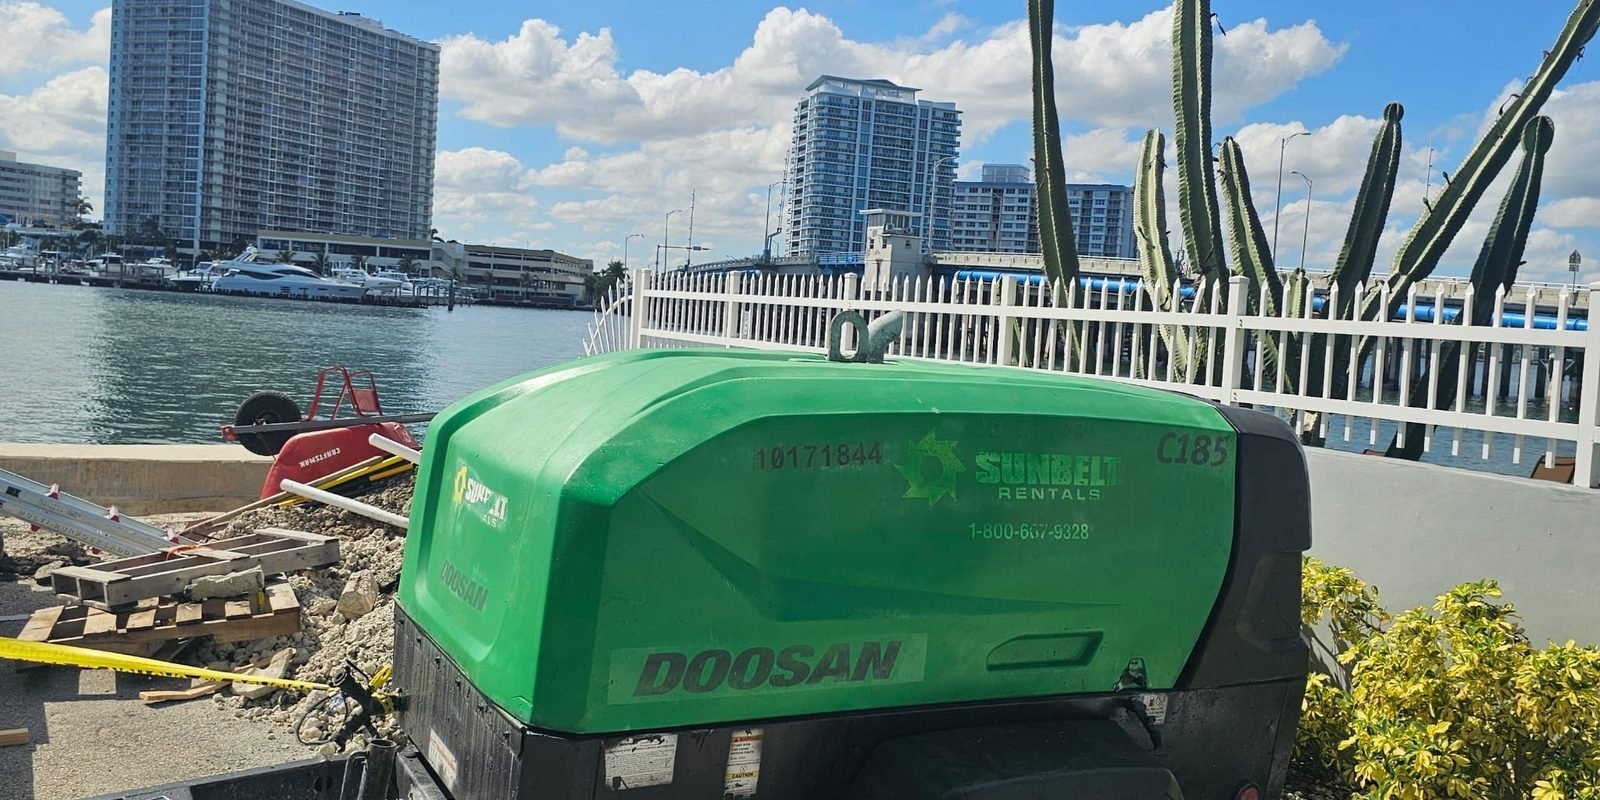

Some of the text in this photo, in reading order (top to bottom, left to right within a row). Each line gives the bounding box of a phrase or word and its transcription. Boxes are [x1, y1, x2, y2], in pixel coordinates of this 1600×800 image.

[299, 447, 341, 468] CRAFTSMAN
[756, 442, 882, 471] 10171844
[1156, 431, 1232, 467] C185
[975, 451, 1122, 487] SUNBELT
[998, 487, 1101, 501] RENTALS
[968, 521, 1089, 540] 1-800-667-9328
[440, 559, 489, 612] DOOSAN
[631, 640, 903, 698] DOOSAN
[731, 771, 754, 779] CAUTION
